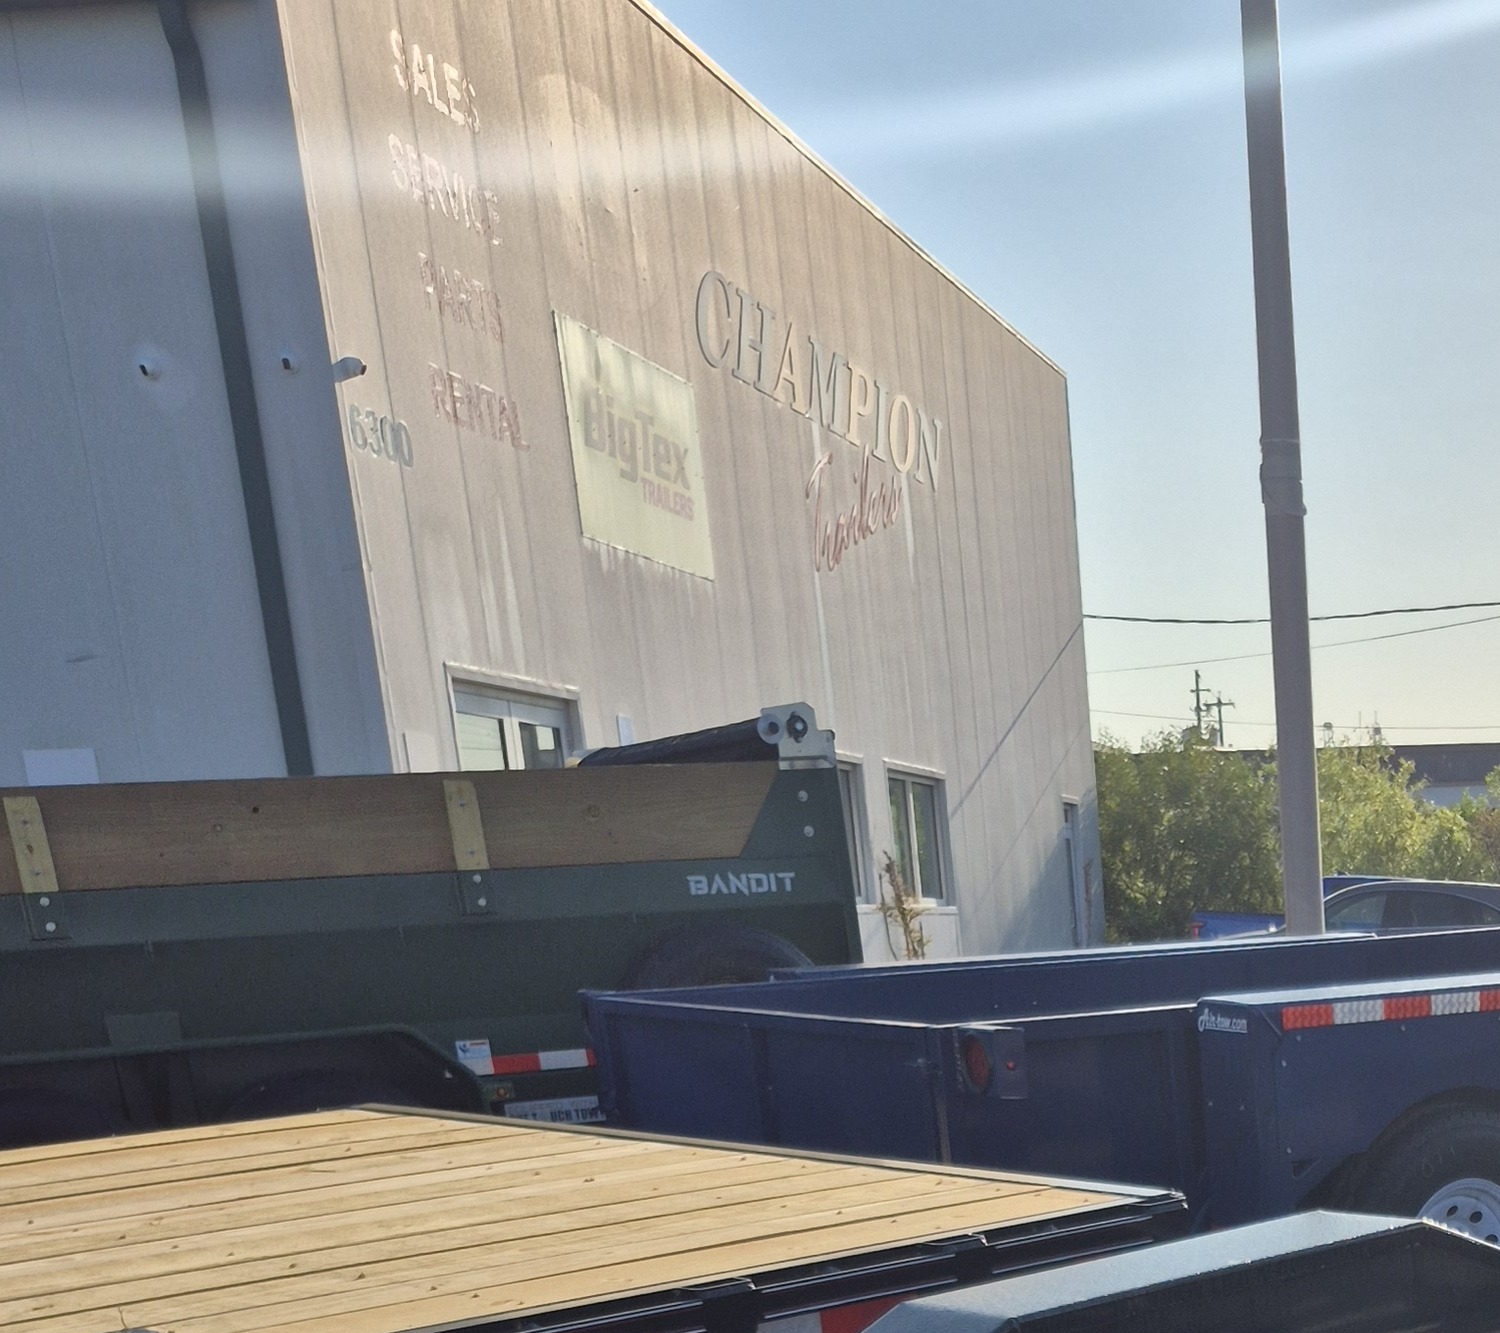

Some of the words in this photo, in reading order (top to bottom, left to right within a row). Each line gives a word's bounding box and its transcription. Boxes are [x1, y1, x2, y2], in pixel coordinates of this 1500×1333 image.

[389, 28, 482, 135] SALES
[387, 132, 503, 246] SERVICE
[417, 250, 506, 345] PARTS
[427, 361, 532, 450] RENTAL
[694, 270, 943, 494] CHAMPION
[350, 402, 414, 468] 6300
[639, 475, 695, 522] TRAILERS
[804, 443, 904, 574] Trailers
[685, 870, 797, 897] BANDIT
